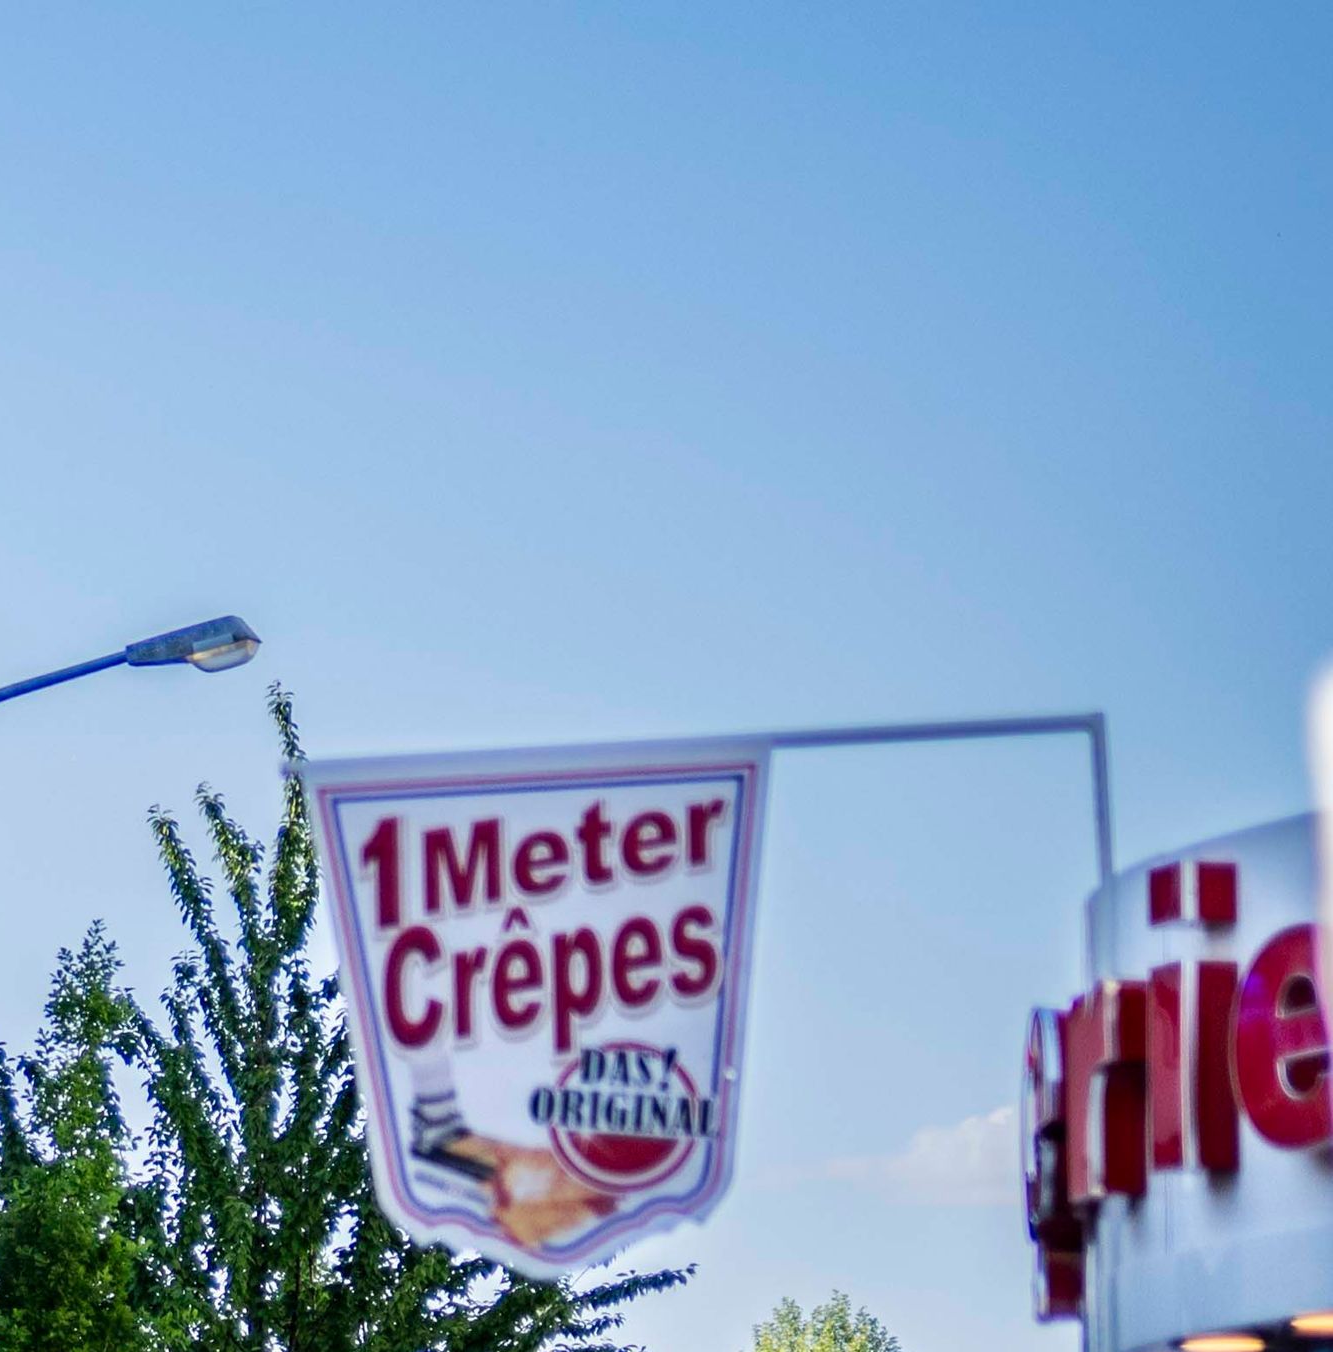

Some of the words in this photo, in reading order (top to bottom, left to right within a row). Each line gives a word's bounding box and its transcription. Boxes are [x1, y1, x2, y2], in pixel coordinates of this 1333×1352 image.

[423, 798, 726, 914] Meter
[384, 905, 721, 1053] Crêpes
[528, 1085, 720, 1139] ORIGINAL
[579, 1047, 677, 1092] DAS!
